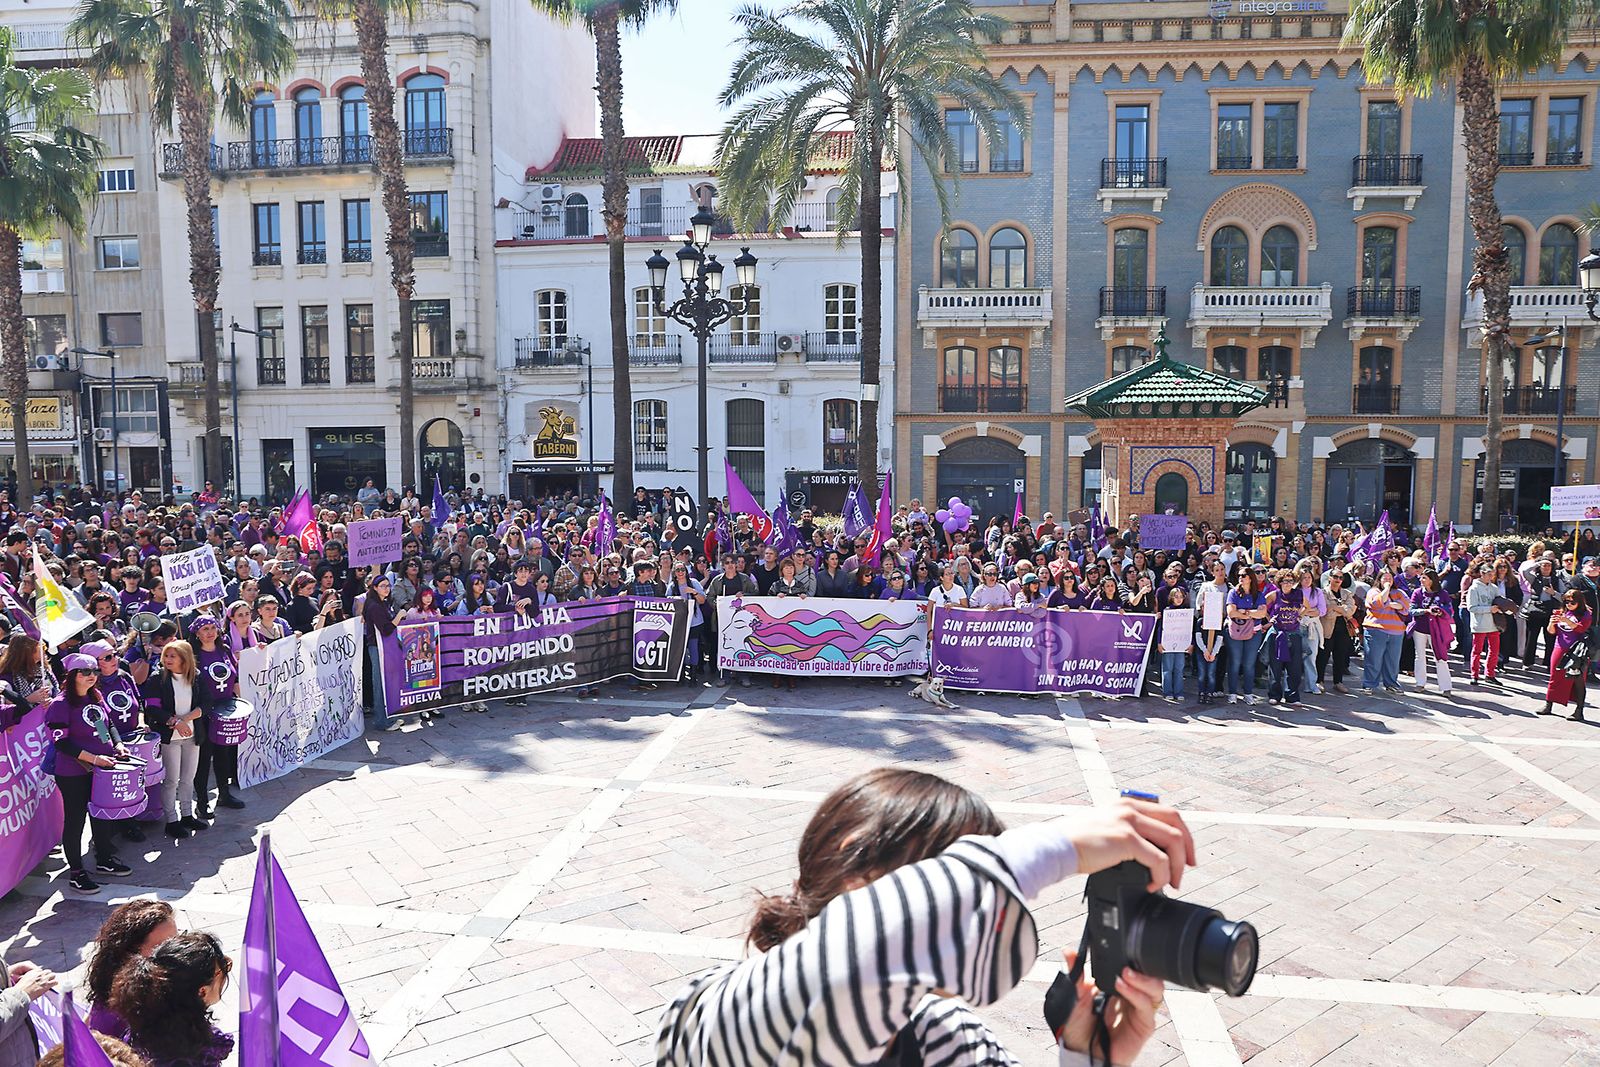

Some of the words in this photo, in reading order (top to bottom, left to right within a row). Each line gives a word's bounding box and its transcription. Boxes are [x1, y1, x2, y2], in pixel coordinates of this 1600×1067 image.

[325, 433, 374, 444] BLISS
[634, 600, 675, 611] HUELVA
[473, 617, 500, 636] EN
[943, 619, 963, 632] SIN
[966, 621, 1033, 633] FEMINISMO
[941, 634, 958, 646] NO
[961, 636, 984, 647] HAY
[987, 636, 1036, 648] CAMBIO.
[463, 633, 574, 666] ROMPIENDO
[635, 640, 667, 666] CGT
[720, 656, 735, 667] Por
[739, 658, 755, 667] una
[757, 658, 796, 669] sociedad
[799, 662, 810, 670] en
[812, 660, 850, 672] igualdad
[852, 662, 858, 673] y
[859, 660, 881, 671] libre
[883, 661, 893, 671] de
[1062, 660, 1077, 672] NO
[1079, 659, 1102, 671] HAY
[463, 662, 577, 696] FRONTERAS
[1038, 674, 1054, 686] SIN
[1058, 674, 1103, 687] TRABAJO
[400, 691, 442, 706] HUELVA
